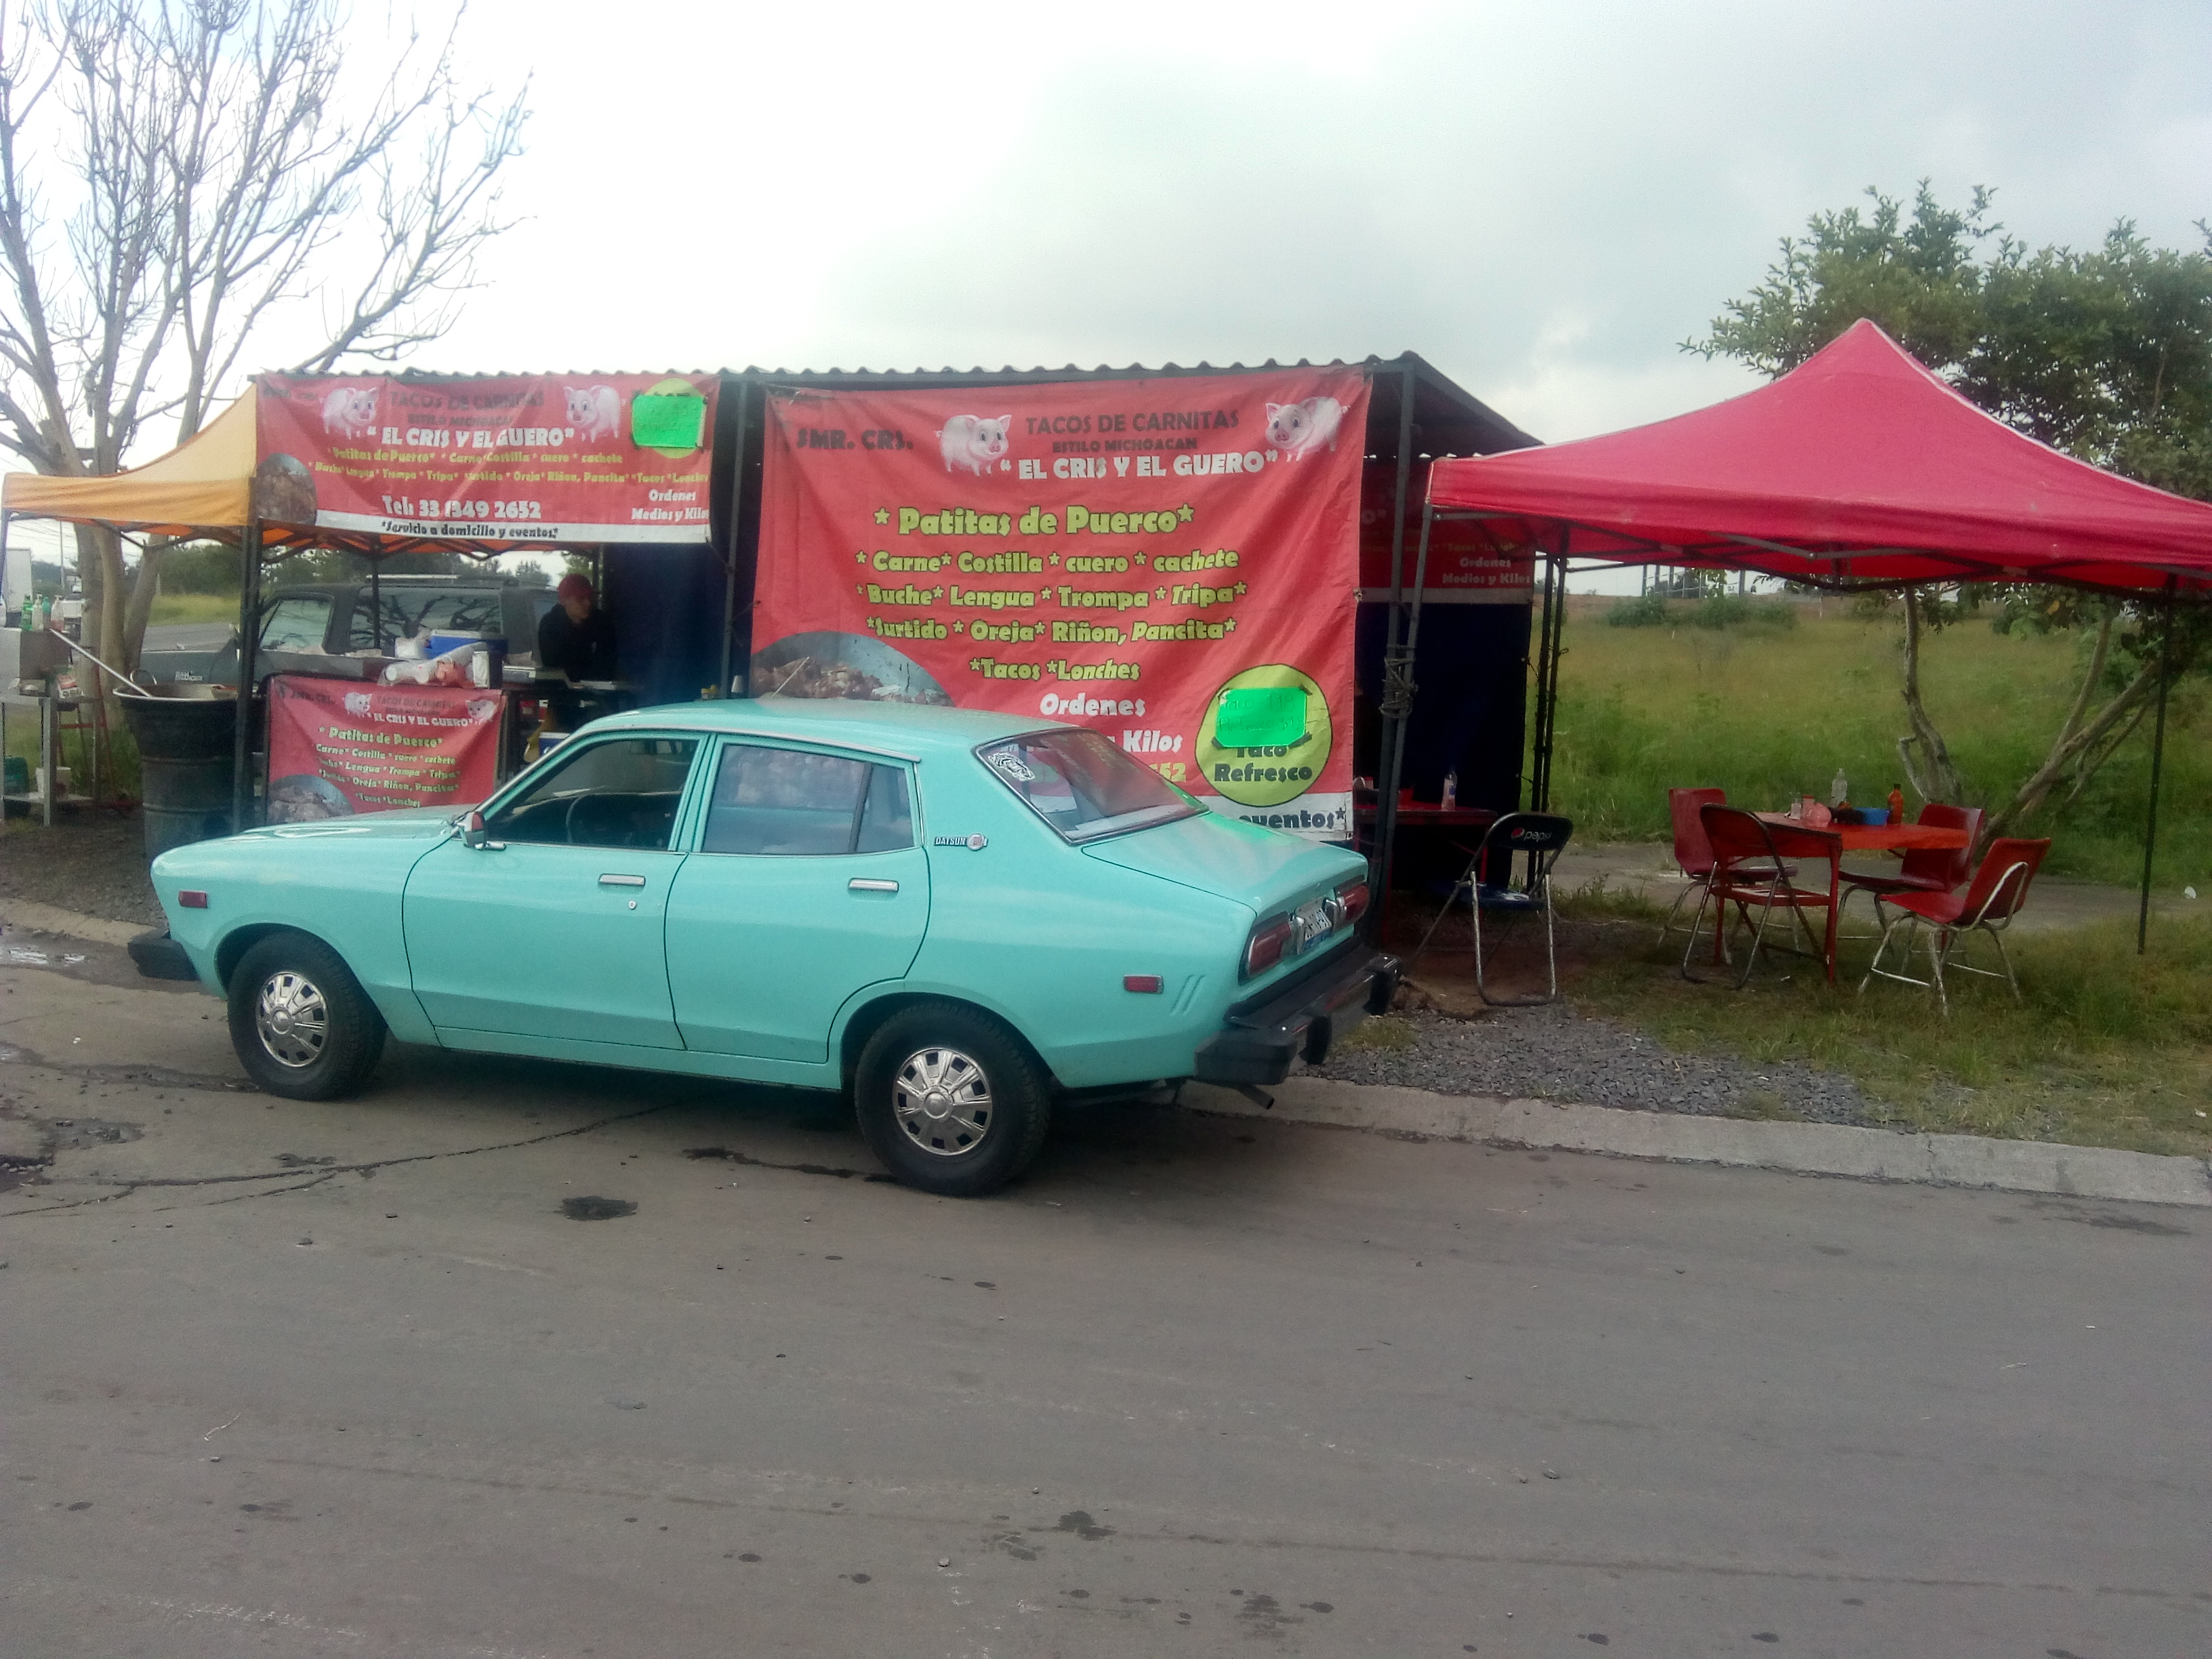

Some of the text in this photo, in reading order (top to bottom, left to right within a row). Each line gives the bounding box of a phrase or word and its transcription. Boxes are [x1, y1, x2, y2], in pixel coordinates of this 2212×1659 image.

[1026, 409, 1240, 434] TACOS DE CARNITAS
[382, 426, 403, 445] EL
[406, 427, 450, 448] CRIS
[455, 430, 470, 447] Y
[472, 430, 494, 448] EL
[1052, 438, 1198, 453] ESTILO MICHOACAN
[1019, 458, 1047, 479] EL
[1053, 457, 1107, 479] CRIS
[1113, 456, 1130, 477] Y
[1136, 456, 1167, 477] EL
[419, 499, 441, 517] 33
[494, 499, 541, 519] 2652
[898, 504, 1179, 537] Patitas de Puerco
[430, 527, 438, 535] a
[498, 528, 506, 538] y
[872, 548, 1240, 574] Carne Costilla cuero cachete
[866, 582, 1235, 611] Buche Lengua Trompa Tripa
[969, 619, 1035, 644] Oreja
[1051, 620, 1128, 646] Riñon,
[1130, 618, 1225, 642] Pancita
[980, 657, 1141, 681] Tacos Lonches
[1040, 692, 1146, 717] Ordenes
[1122, 729, 1183, 754] Kilos
[1149, 762, 1187, 783] 52
[1214, 762, 1313, 783] Refresco
[935, 836, 966, 845] DATSUN
